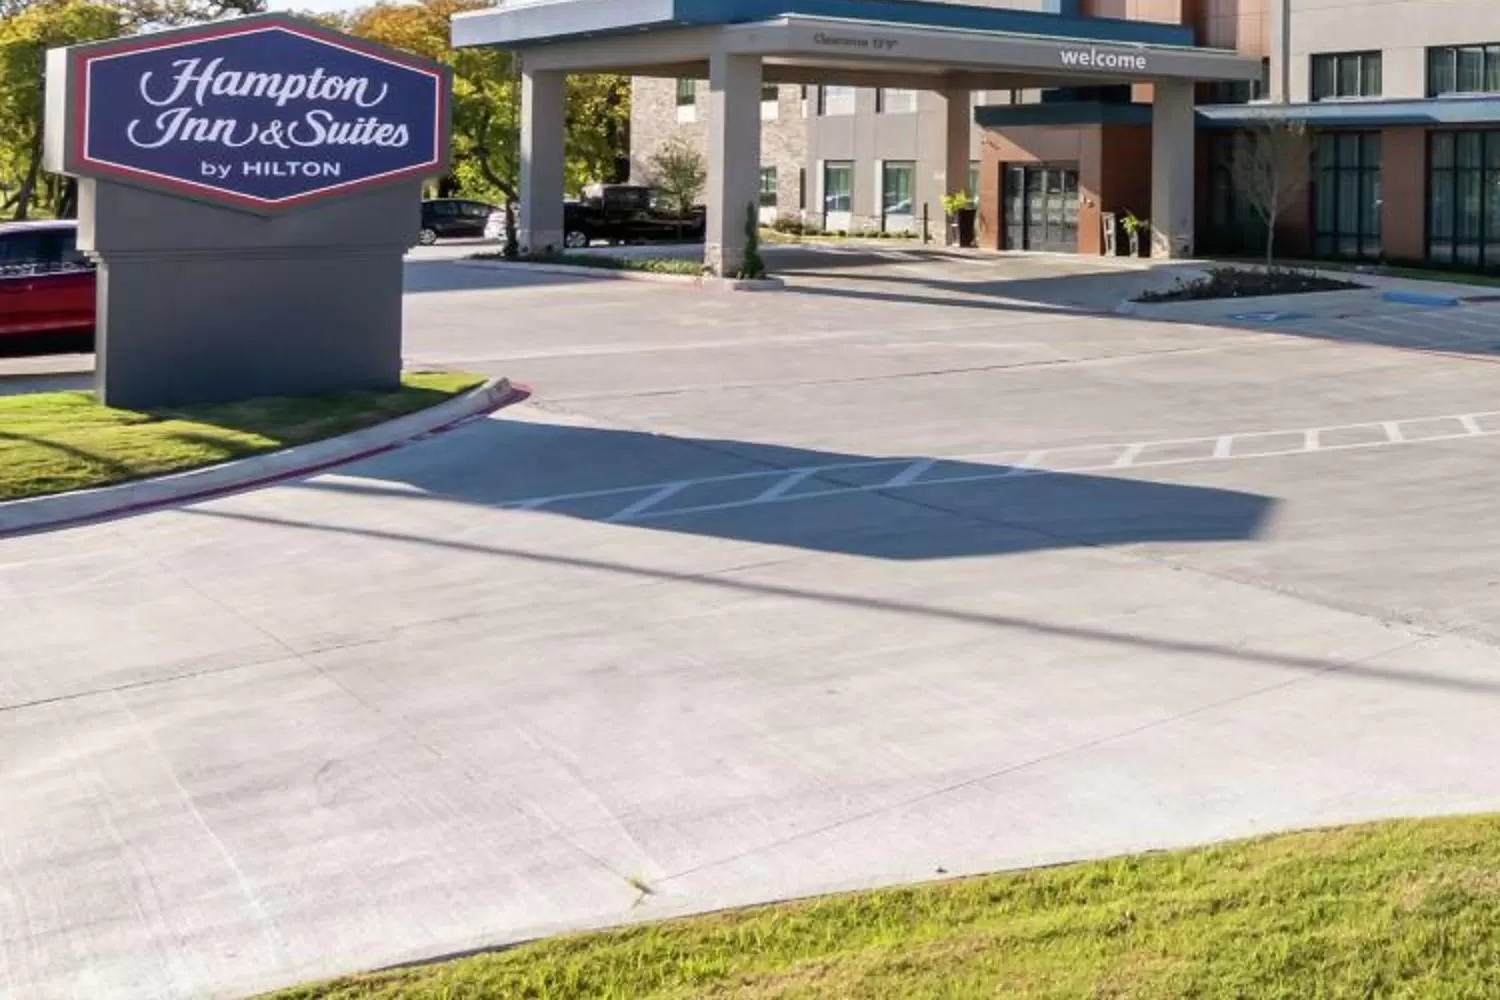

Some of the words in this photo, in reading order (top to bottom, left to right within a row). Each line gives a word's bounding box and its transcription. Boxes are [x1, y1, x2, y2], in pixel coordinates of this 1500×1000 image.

[1060, 45, 1147, 69] welcome
[140, 56, 388, 108] Hampton
[127, 105, 259, 149] Inn
[259, 119, 290, 149] &
[288, 110, 410, 149] Suites
[201, 161, 230, 179] by
[243, 161, 341, 177] HILTON
